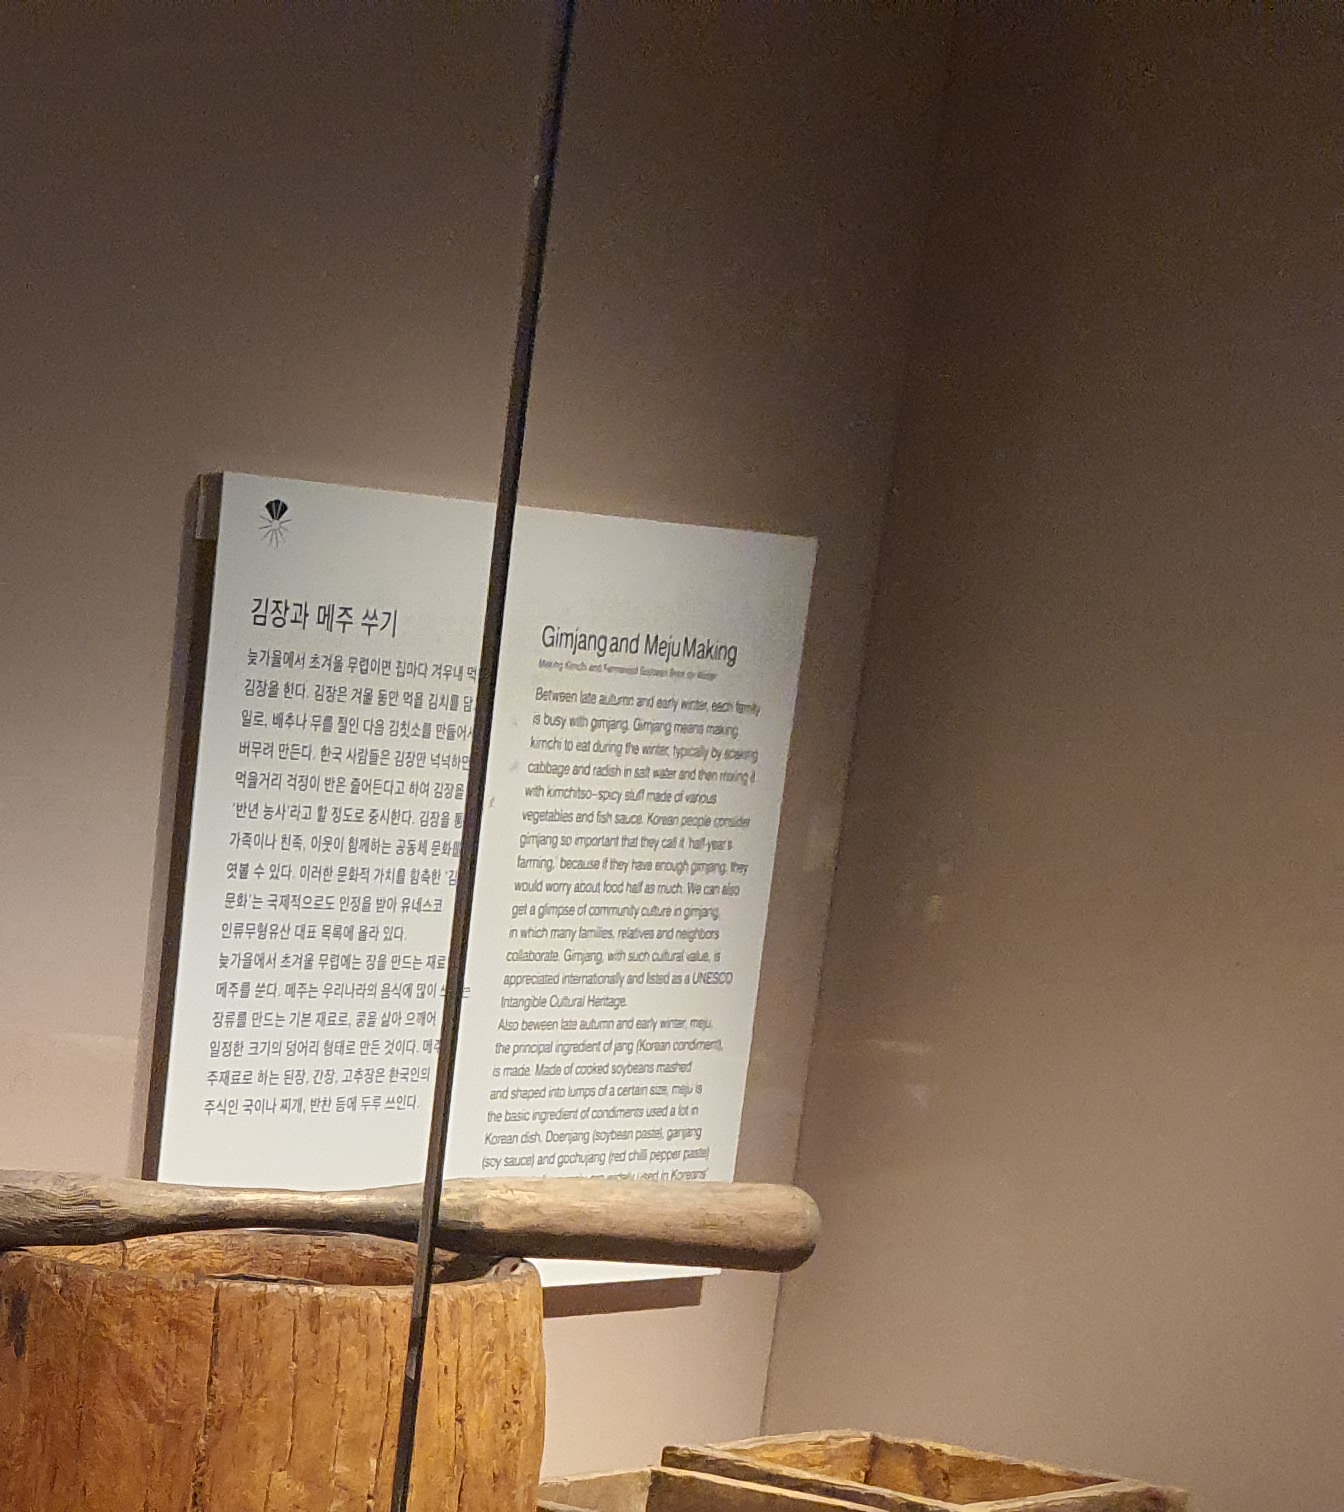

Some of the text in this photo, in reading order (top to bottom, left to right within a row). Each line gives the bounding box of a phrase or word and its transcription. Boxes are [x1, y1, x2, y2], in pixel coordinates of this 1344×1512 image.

[251, 597, 397, 638] 김장과 메주 쑤기
[541, 624, 737, 667] Gimjang and Meju Making
[238, 740, 426, 768] 버무려 만든다. 한국 사람들은 김장만
[235, 770, 464, 800] 먹을거리 걱정이 반은 줄어든다고 하여 김장을
[224, 891, 442, 913] 문화'는 국제적으로도 인정을 받아 유네스코
[221, 921, 406, 941] 인류무형유산 대표 목록에 올라 있다.
[205, 1066, 430, 1086] 주재료로 하는 된장, 간장, 고추장은 한국인의
[203, 1094, 419, 1115] 주식인 국이나 찌개, 반찬 등에 두루 쓰인다.
